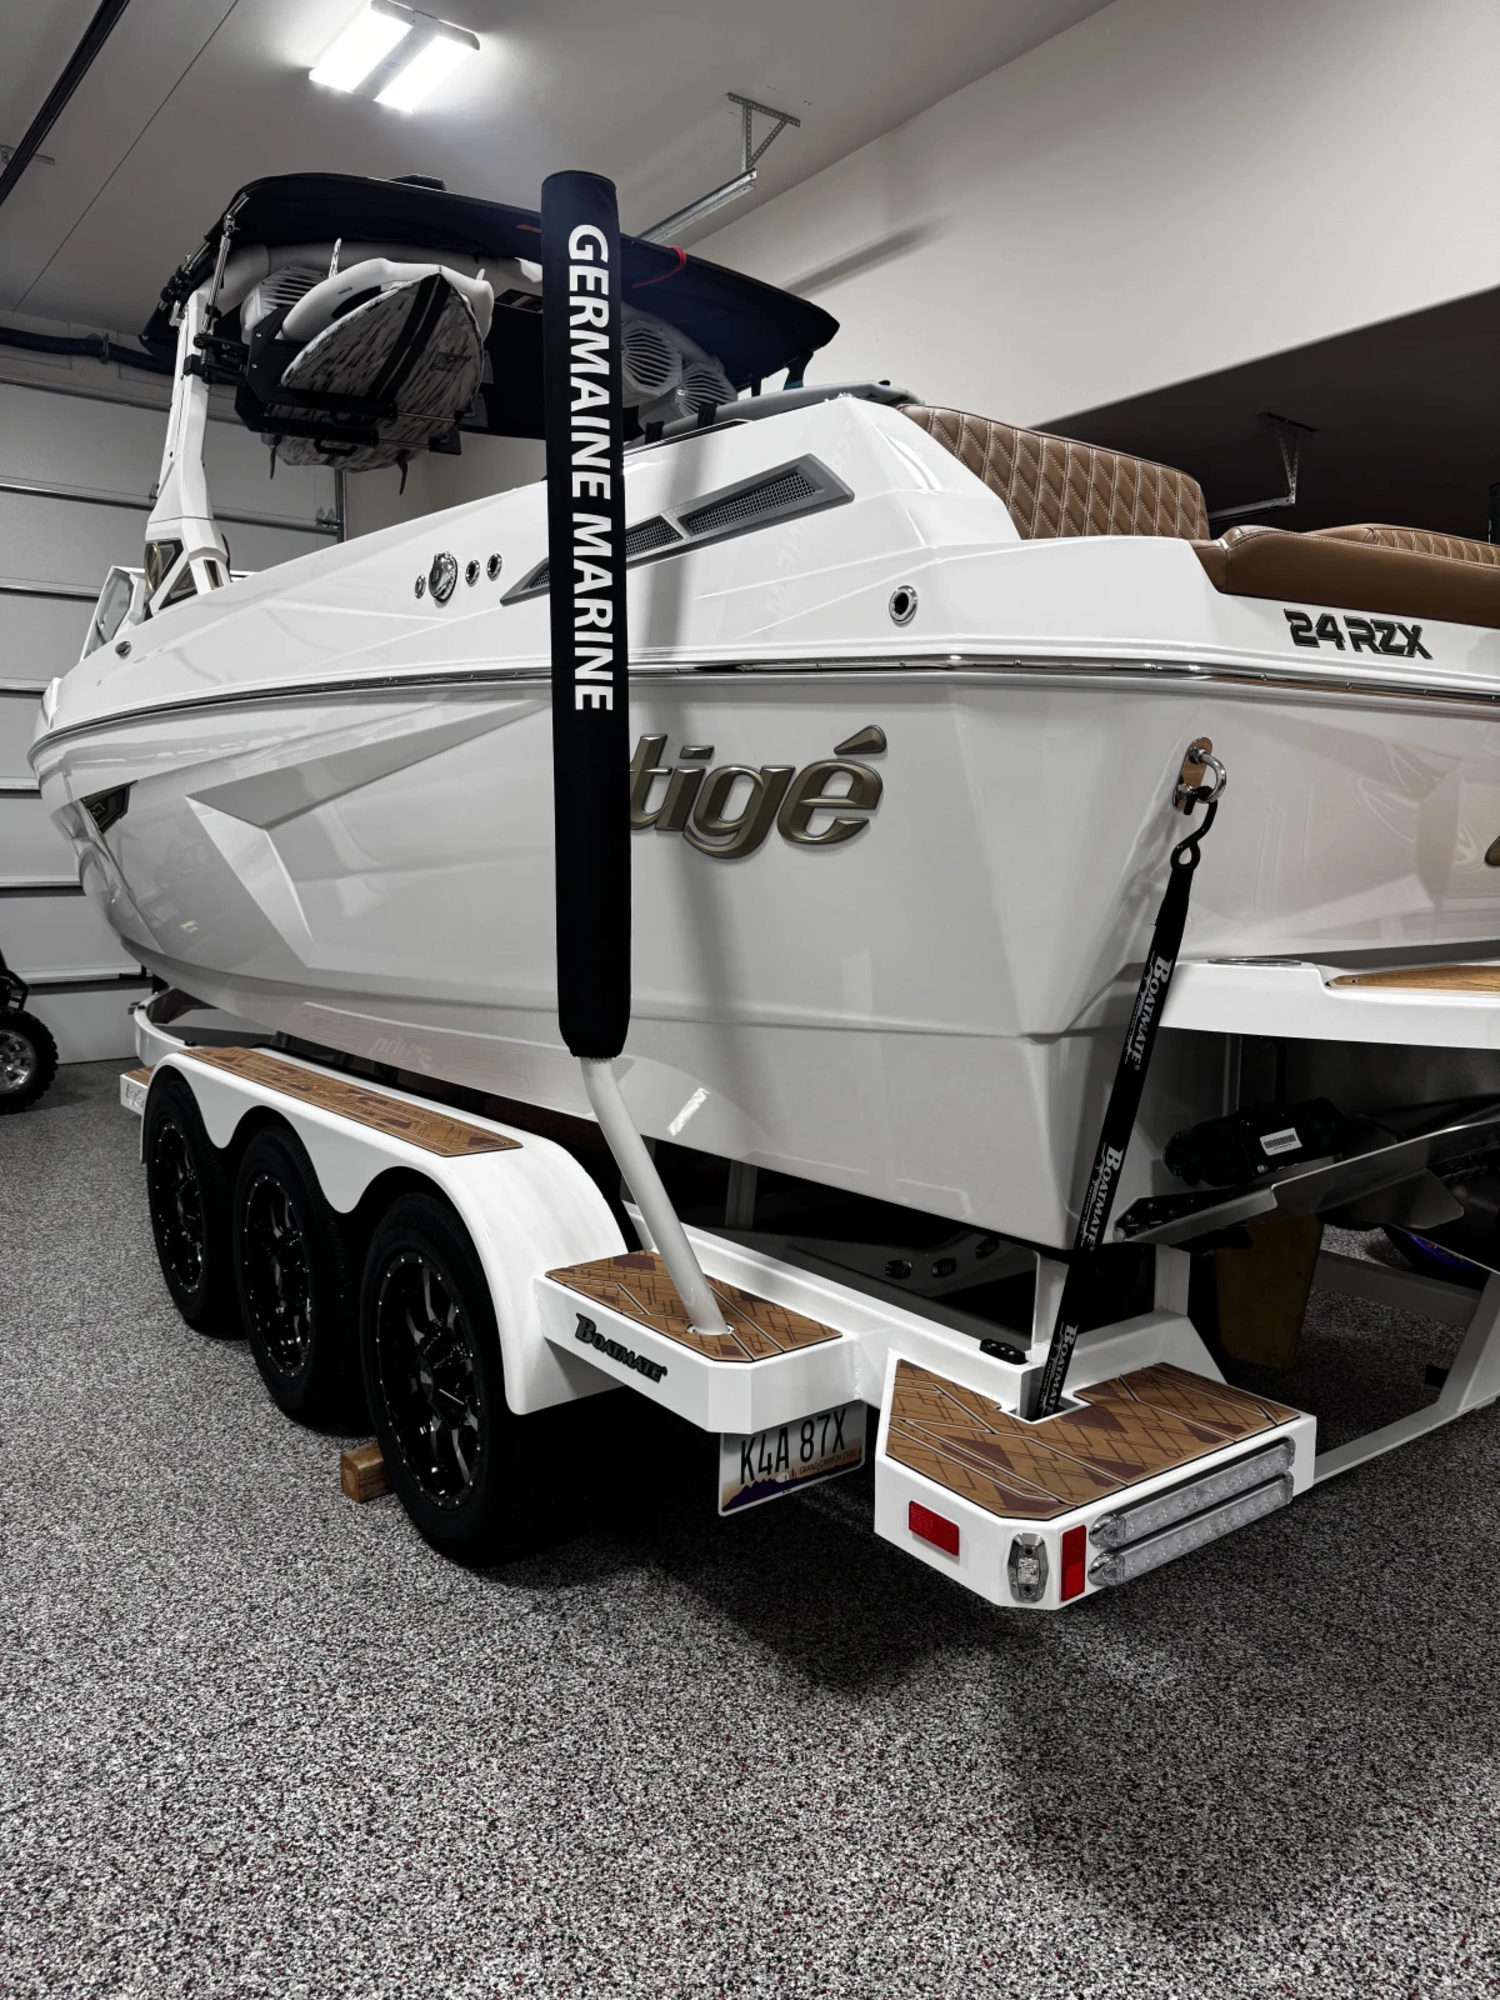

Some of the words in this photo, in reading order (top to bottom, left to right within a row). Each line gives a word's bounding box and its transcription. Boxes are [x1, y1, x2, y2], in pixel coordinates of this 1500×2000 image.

[568, 224, 611, 499] GERMAINE
[572, 512, 614, 711] MARINE
[1284, 608, 1346, 650] 24
[1344, 615, 1434, 660] RZX
[630, 724, 887, 859] tigé
[740, 1426, 789, 1485] K4A
[800, 1408, 847, 1463] 87X
